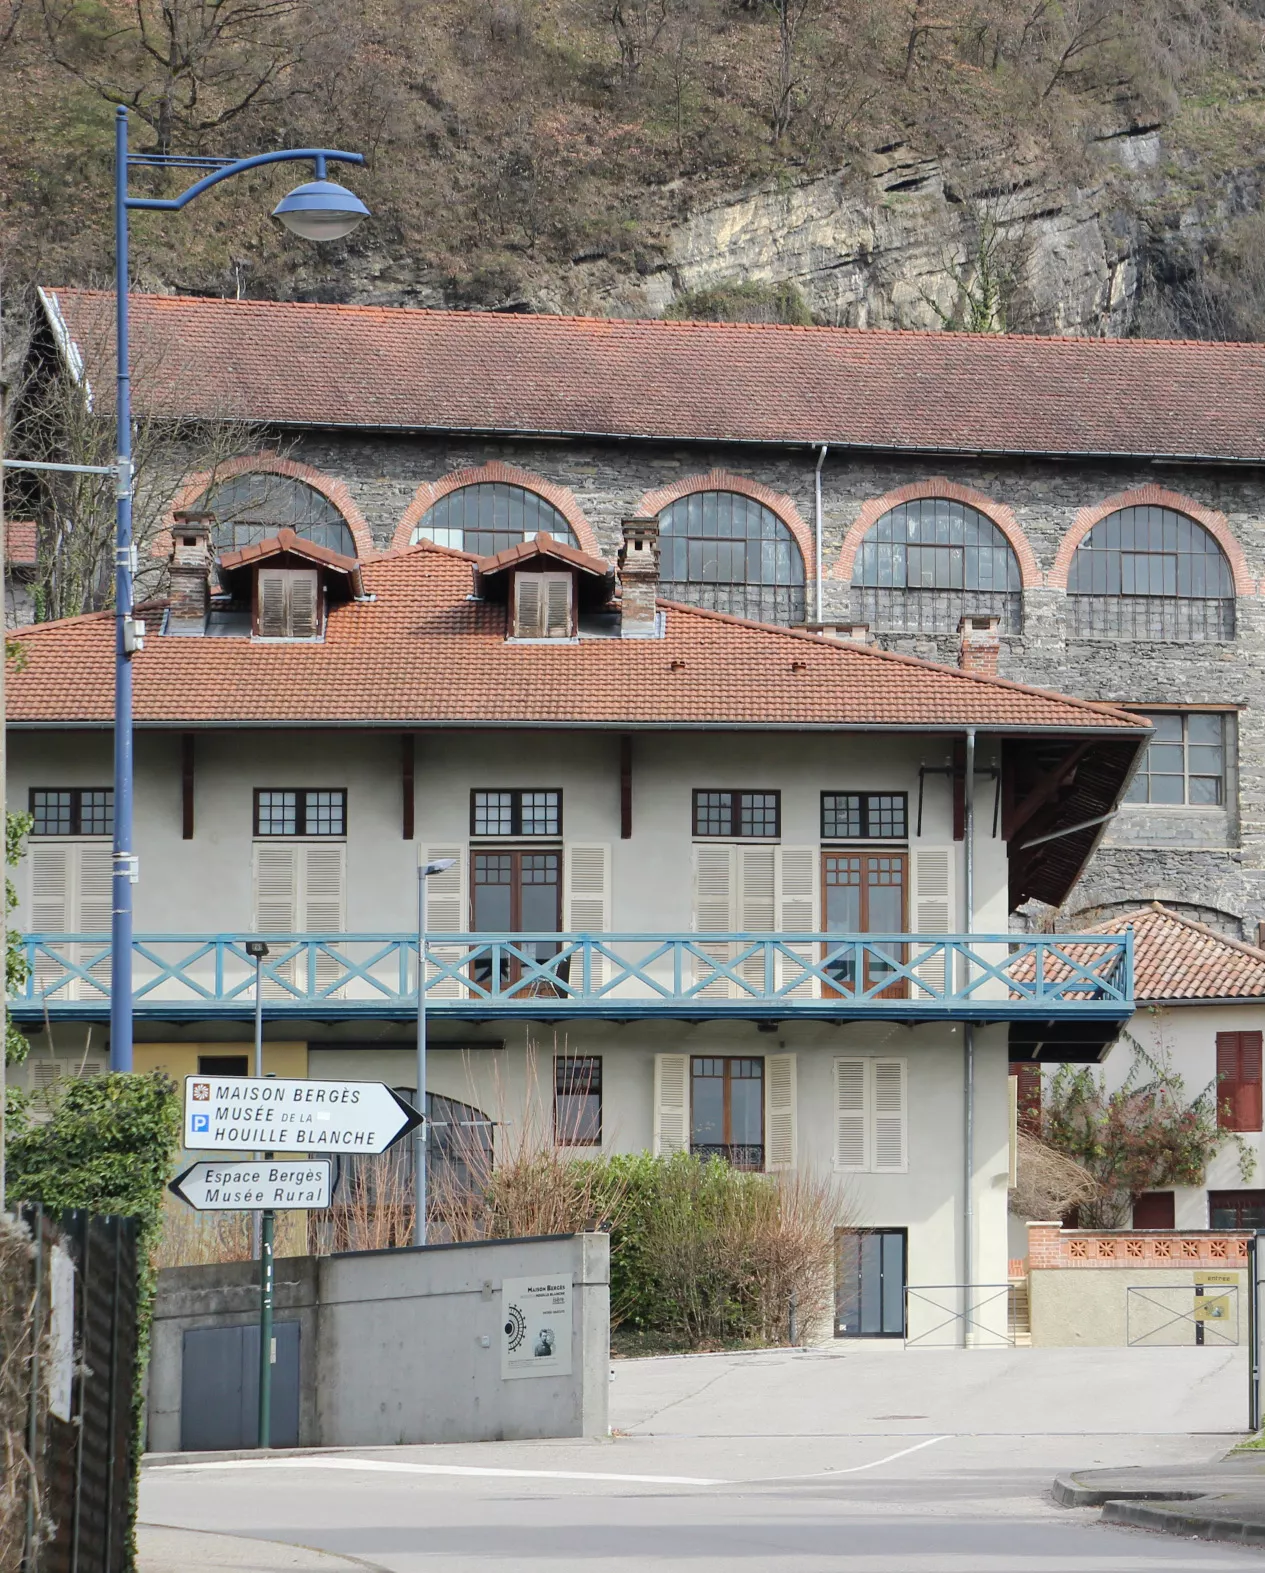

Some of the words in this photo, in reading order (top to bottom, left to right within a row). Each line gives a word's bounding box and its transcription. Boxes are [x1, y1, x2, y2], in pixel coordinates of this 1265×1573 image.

[215, 1086, 286, 1102] MAISON
[293, 1087, 361, 1104] BERGÈS
[215, 1105, 275, 1122] MUSÉE
[281, 1113, 296, 1123] DE
[300, 1113, 313, 1123] LA
[214, 1128, 288, 1143] HOUILLE
[296, 1130, 376, 1146] BLANCHE
[205, 1169, 261, 1186] Espace
[268, 1168, 323, 1185] Bergès
[205, 1189, 264, 1203] Musée
[273, 1188, 323, 1202] Rural
